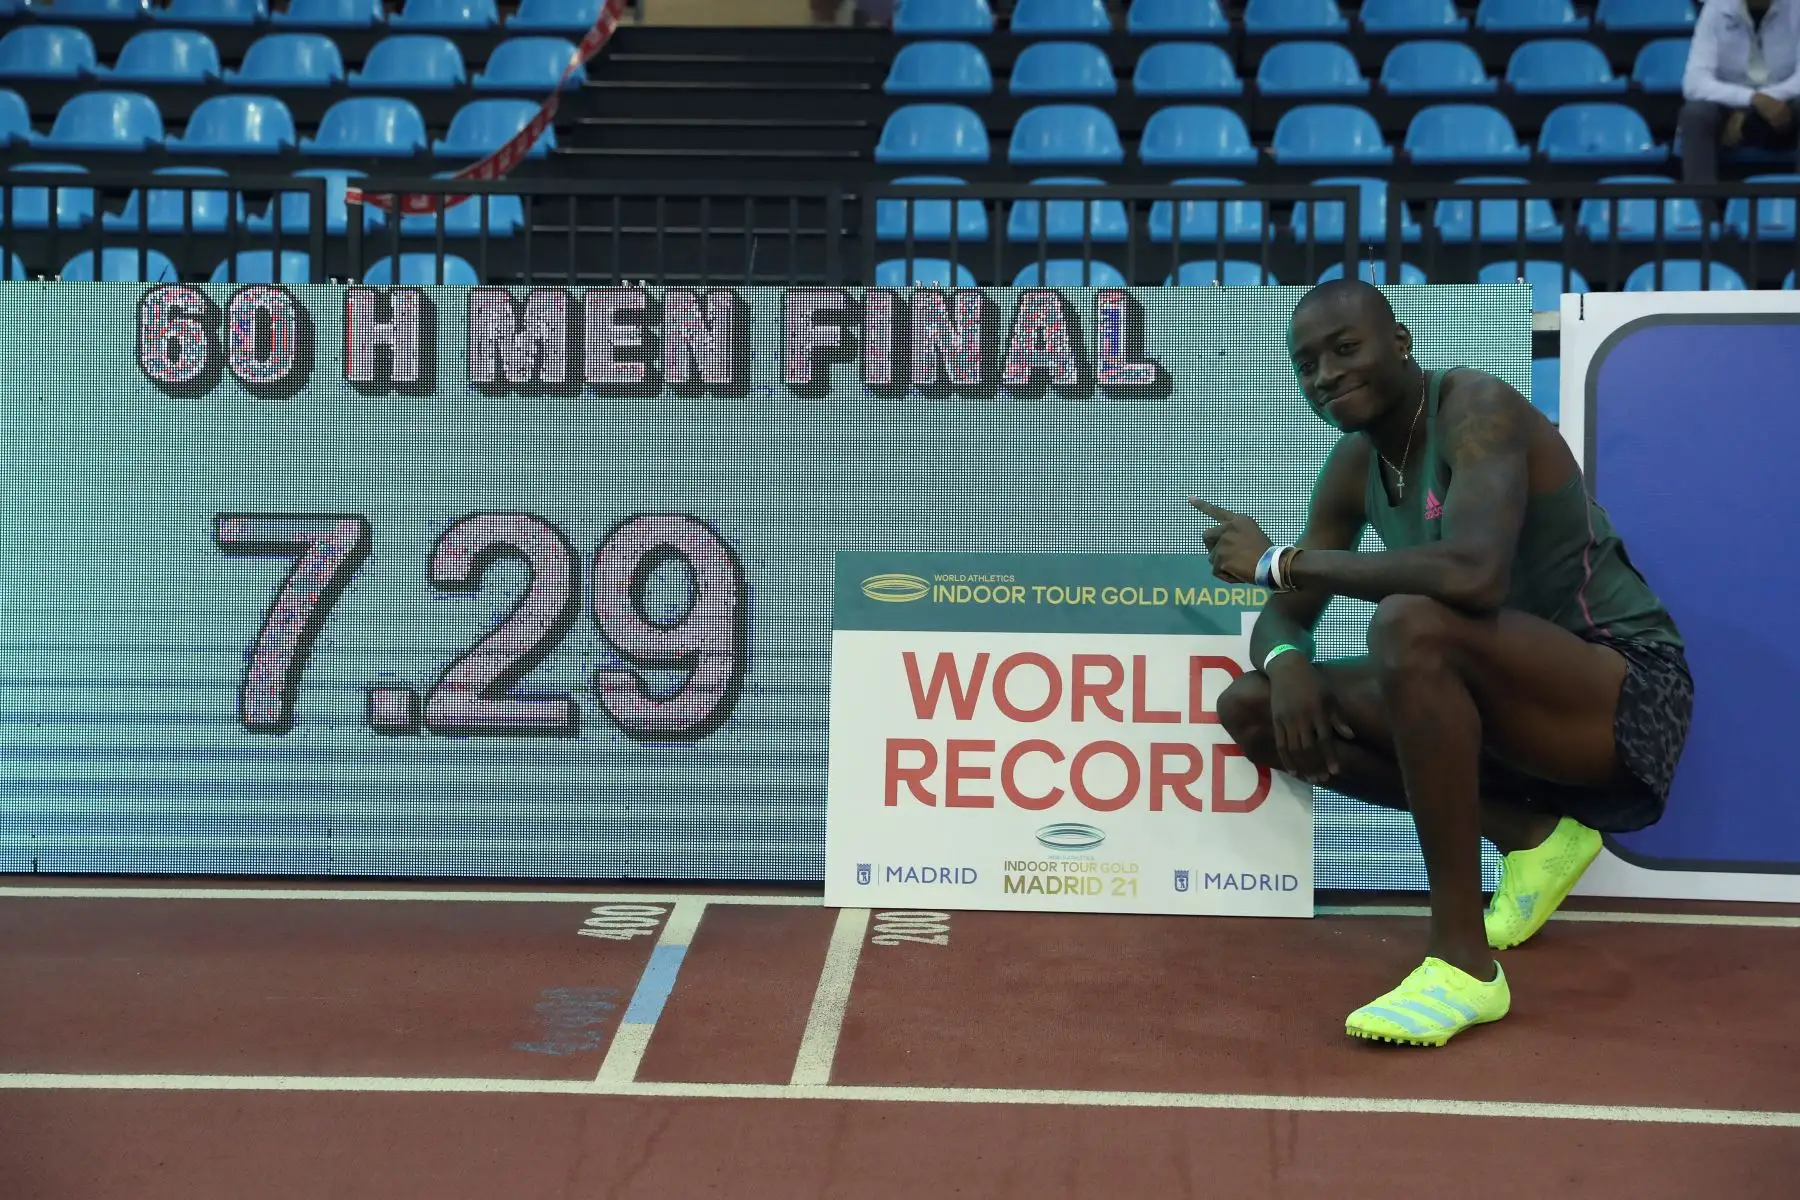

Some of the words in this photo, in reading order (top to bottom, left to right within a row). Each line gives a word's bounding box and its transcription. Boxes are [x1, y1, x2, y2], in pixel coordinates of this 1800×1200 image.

[138, 284, 313, 399] 60
[343, 286, 437, 396] H
[467, 286, 750, 398] MEN
[781, 288, 1173, 400] FINAL
[934, 573, 965, 583] WORLD
[967, 574, 1015, 584] ATHLETICS
[933, 585, 1026, 605] INDOOR
[1032, 586, 1096, 605] TOUR
[1101, 587, 1169, 606] GOLD
[1174, 588, 1269, 607] MADRID
[213, 512, 746, 741] 7.29
[902, 651, 1245, 724] WORLD
[884, 738, 1272, 813] RECORD
[886, 865, 978, 885] MADRID
[1004, 860, 1058, 872] INDOOR
[1060, 861, 1098, 873] TOUR
[1100, 862, 1140, 874] GOLD
[1003, 874, 1104, 896] MADRID
[1110, 876, 1139, 897] 21
[1204, 872, 1299, 892] MADRID
[577, 904, 667, 941] 400
[871, 911, 951, 946] 200
